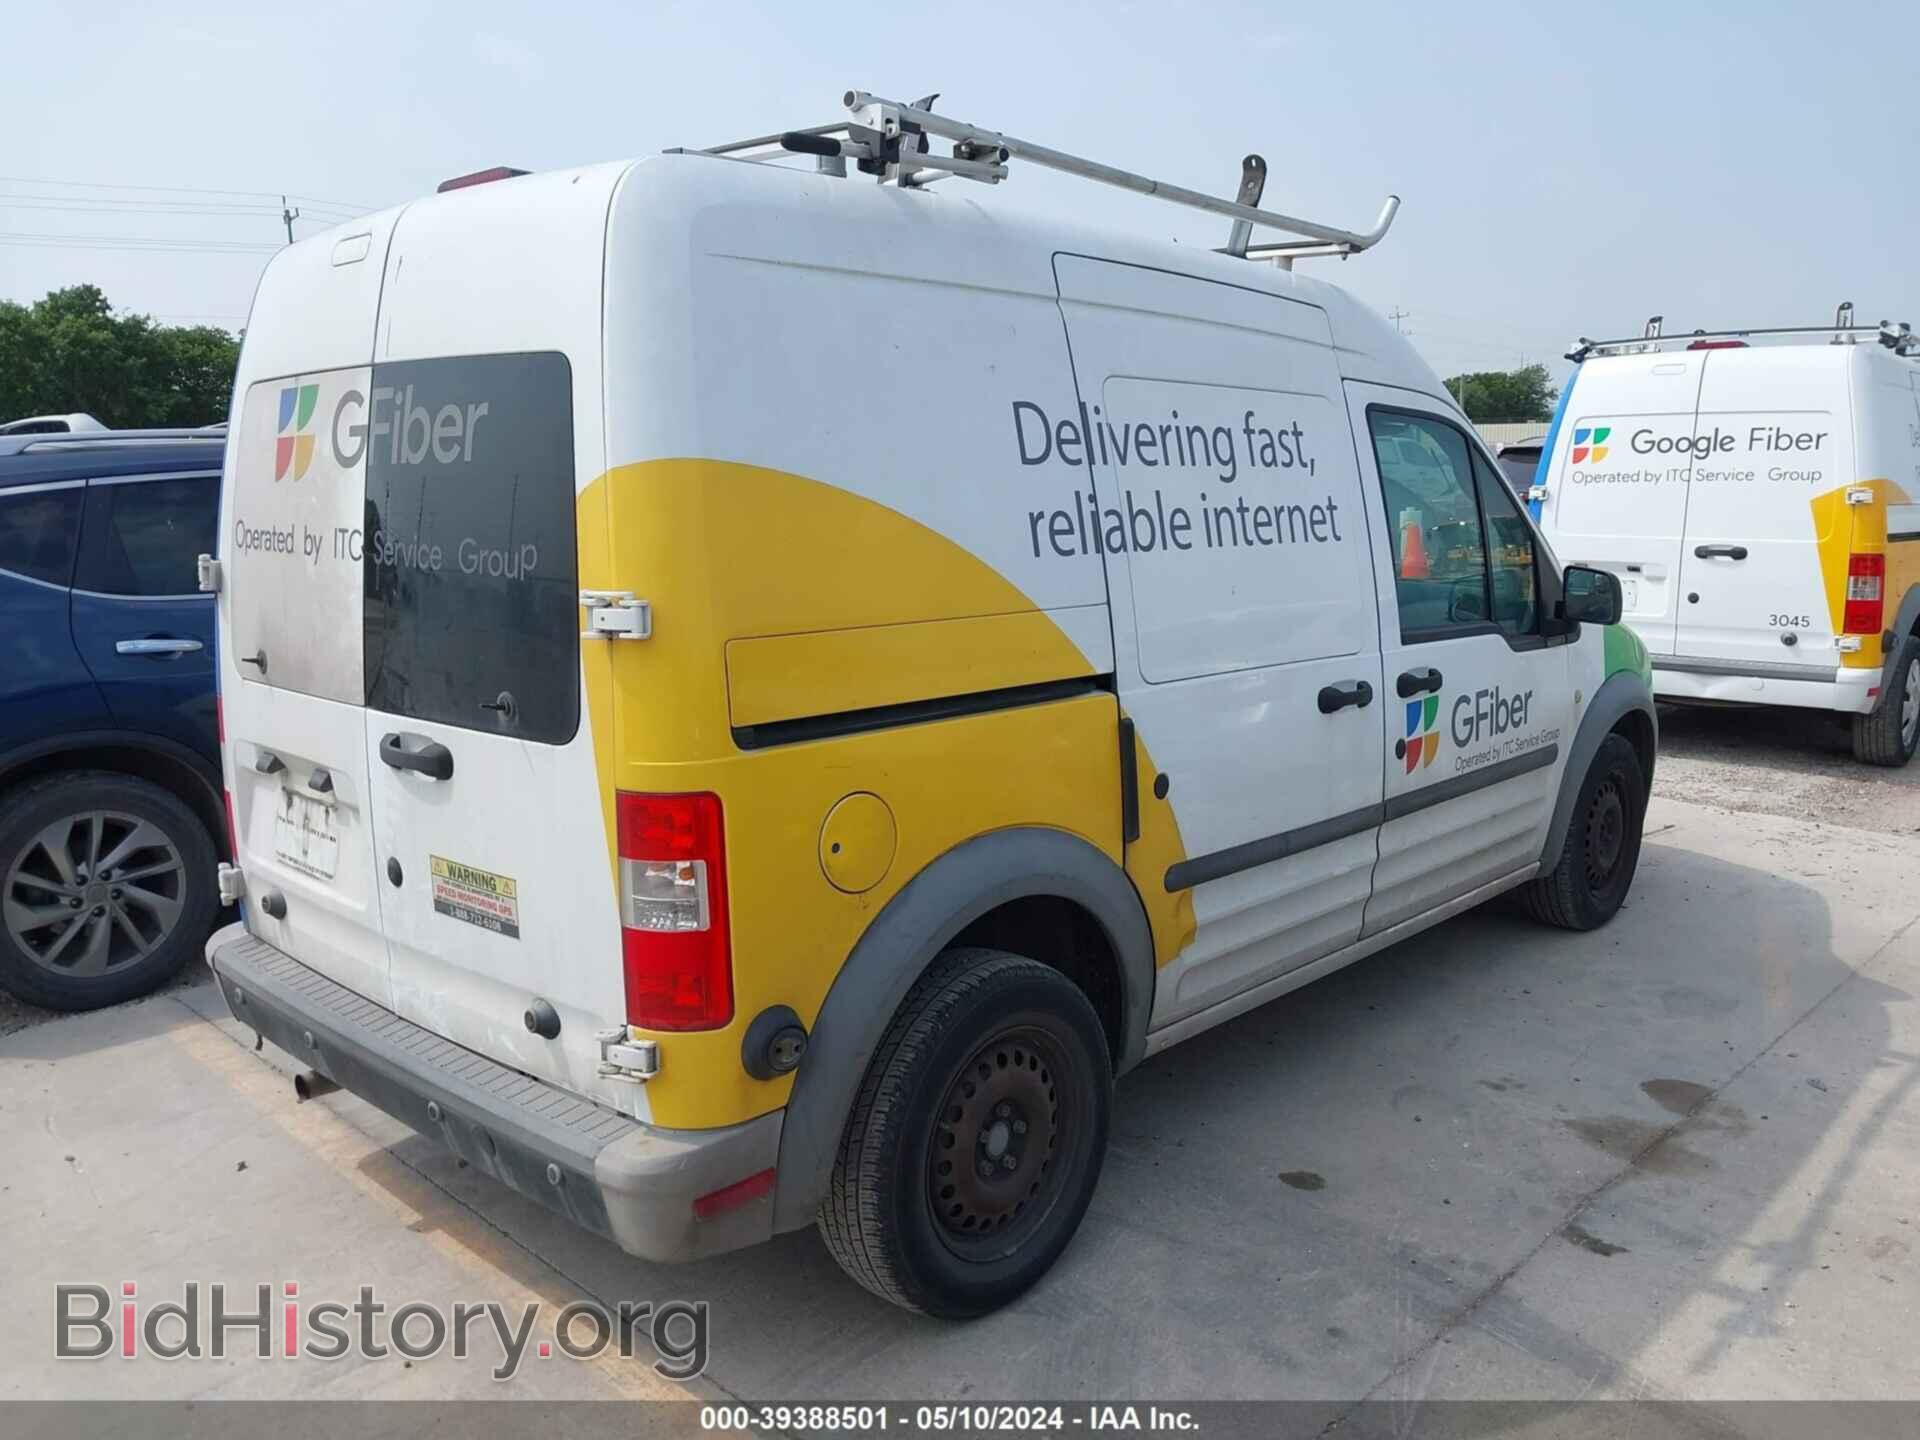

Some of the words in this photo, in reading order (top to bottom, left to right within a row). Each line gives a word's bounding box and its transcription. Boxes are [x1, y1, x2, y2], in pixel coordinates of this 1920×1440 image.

[331, 383, 488, 468] GFiber
[1012, 400, 1237, 483] Delivering
[1243, 410, 1315, 477] fast,
[1631, 428, 1736, 460] Google
[1748, 426, 1829, 451] Fiber
[1571, 469, 1639, 486] Operated
[1644, 468, 1662, 485] by
[1666, 469, 1691, 483] ITC
[1696, 467, 1755, 482] Service
[1767, 467, 1823, 483] Group
[235, 520, 295, 556] Operated
[303, 524, 323, 567] by
[333, 527, 365, 562] ITC
[373, 529, 443, 572] Service
[458, 536, 538, 582] Group
[1028, 490, 1193, 558] reliable
[1199, 492, 1342, 548] internet
[1768, 614, 1811, 628] 3045
[1451, 685, 1533, 748] GFiber
[448, 862, 497, 891] WARNING
